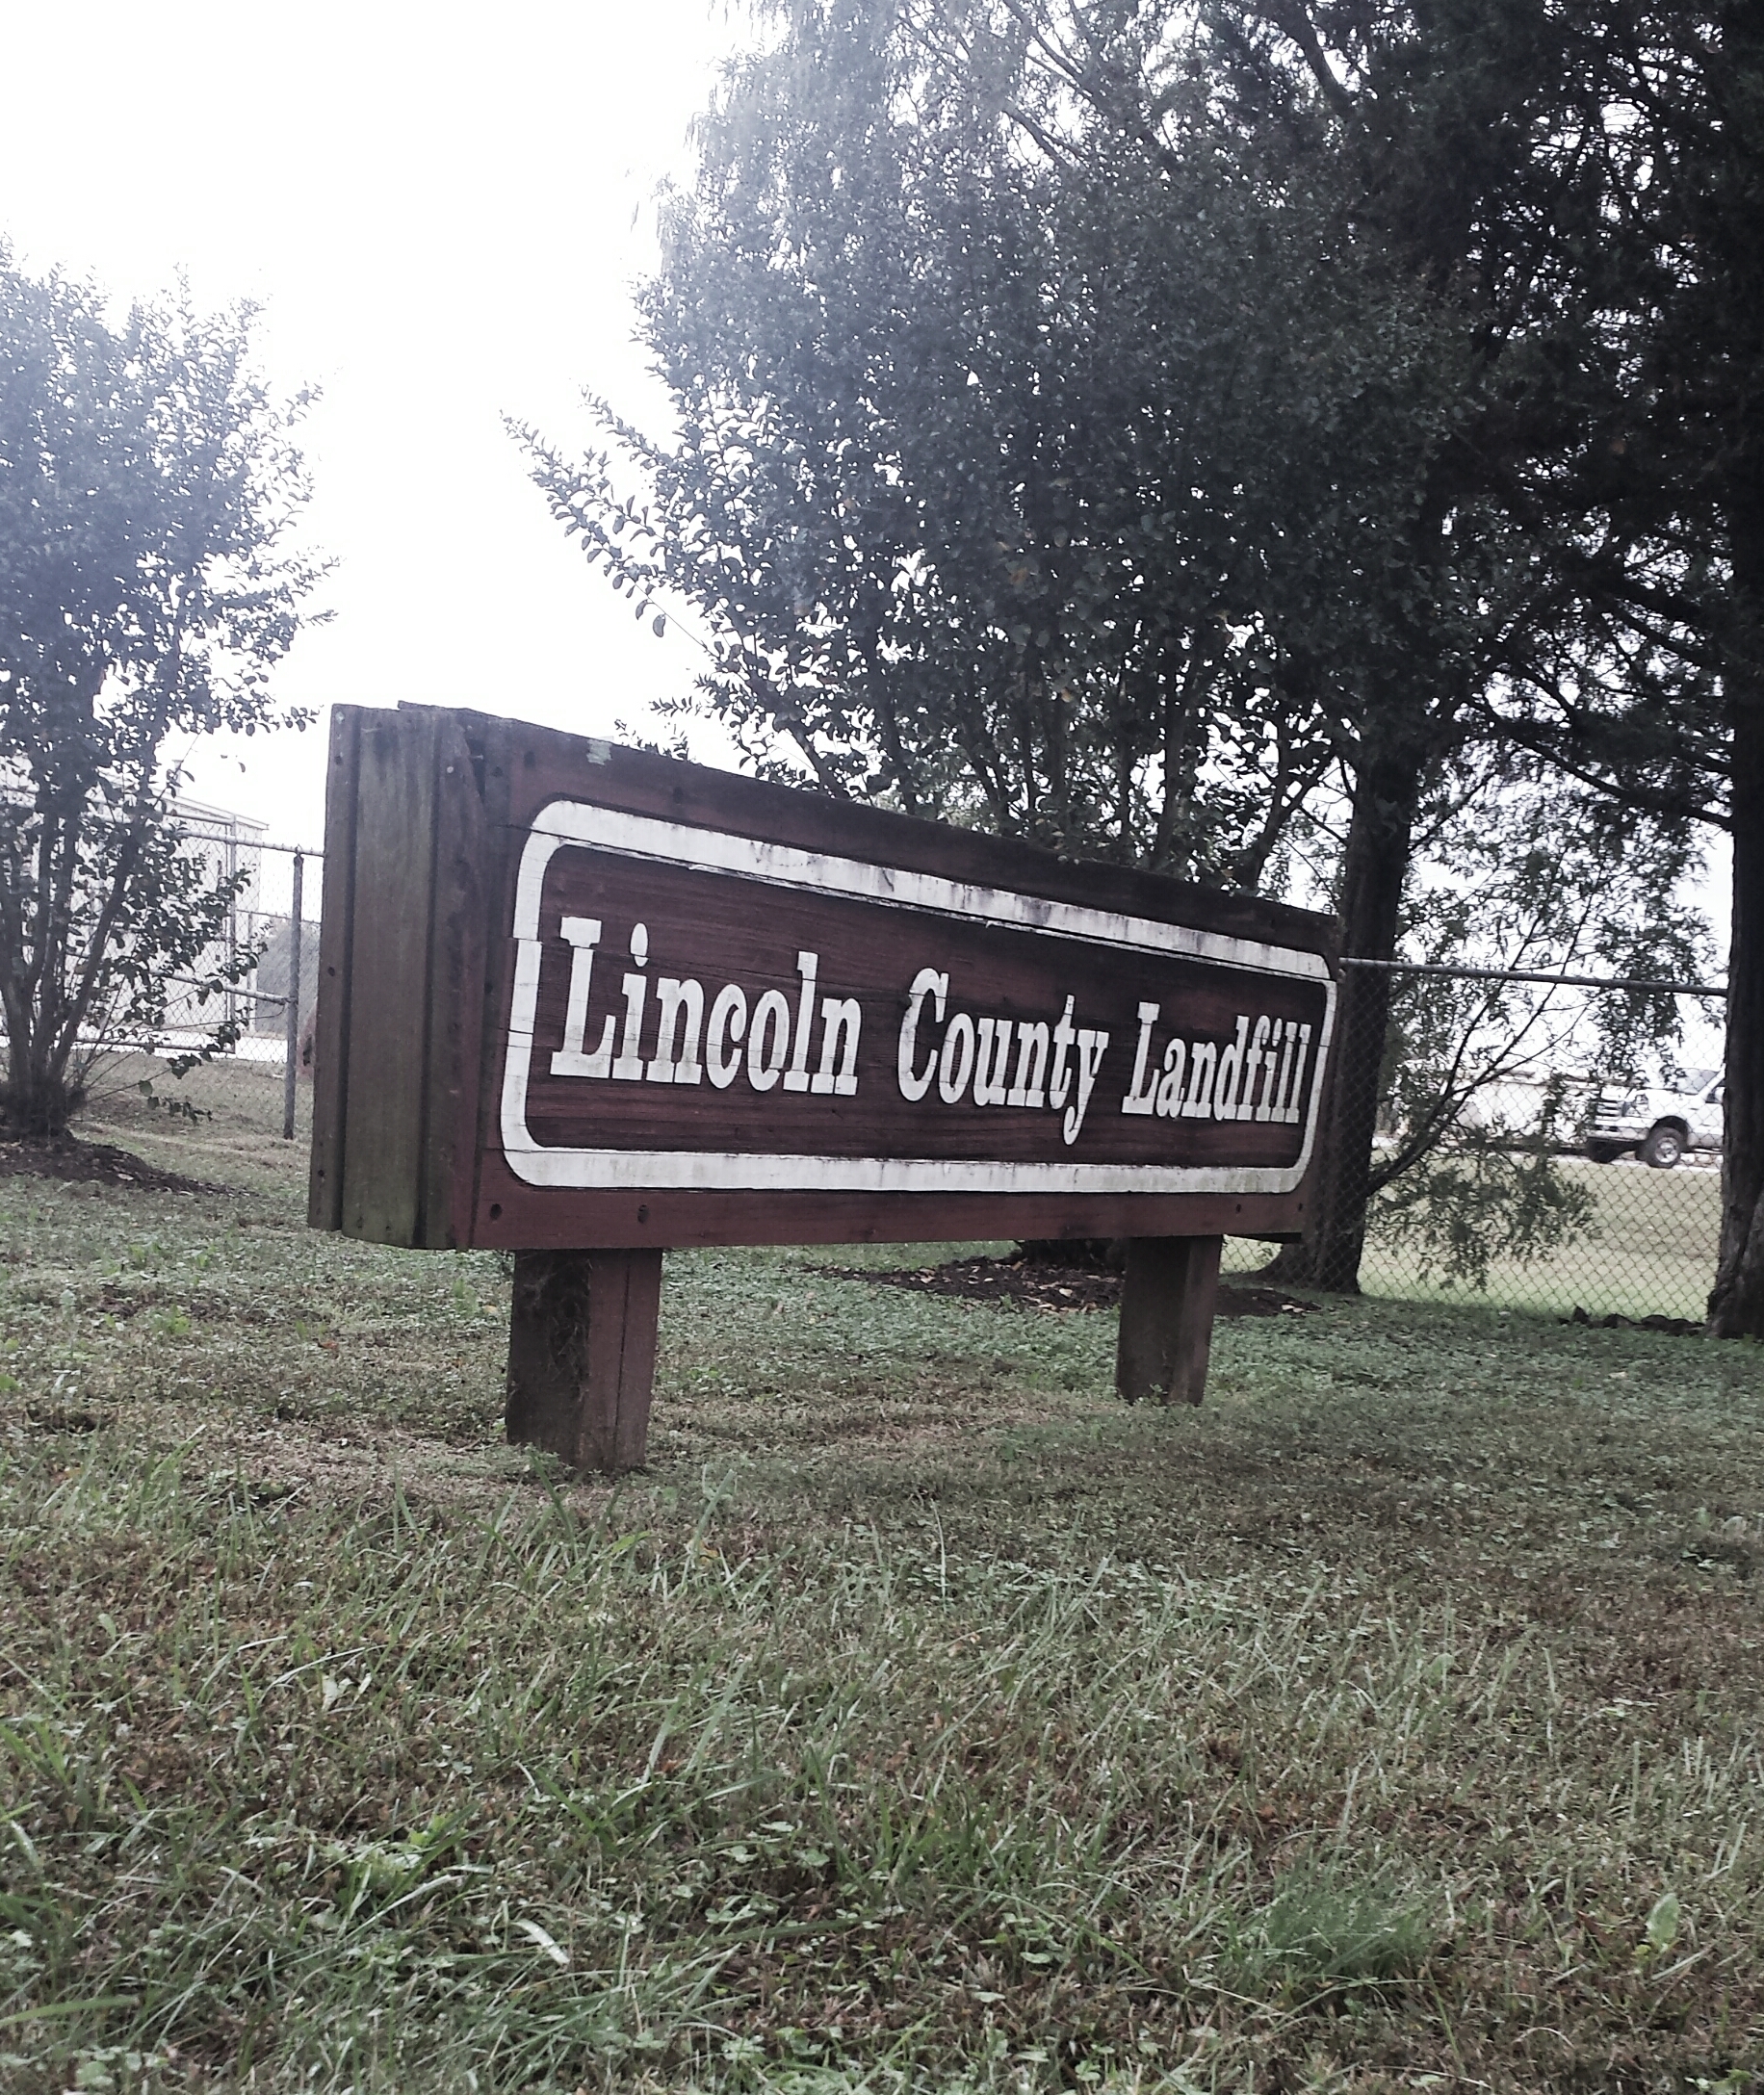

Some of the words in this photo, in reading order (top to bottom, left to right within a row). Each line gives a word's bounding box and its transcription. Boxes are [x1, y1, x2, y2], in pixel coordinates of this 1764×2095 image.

[550, 916, 863, 1097] Lincoln
[897, 967, 1110, 1147] County
[1121, 1001, 1312, 1125] Landfill
